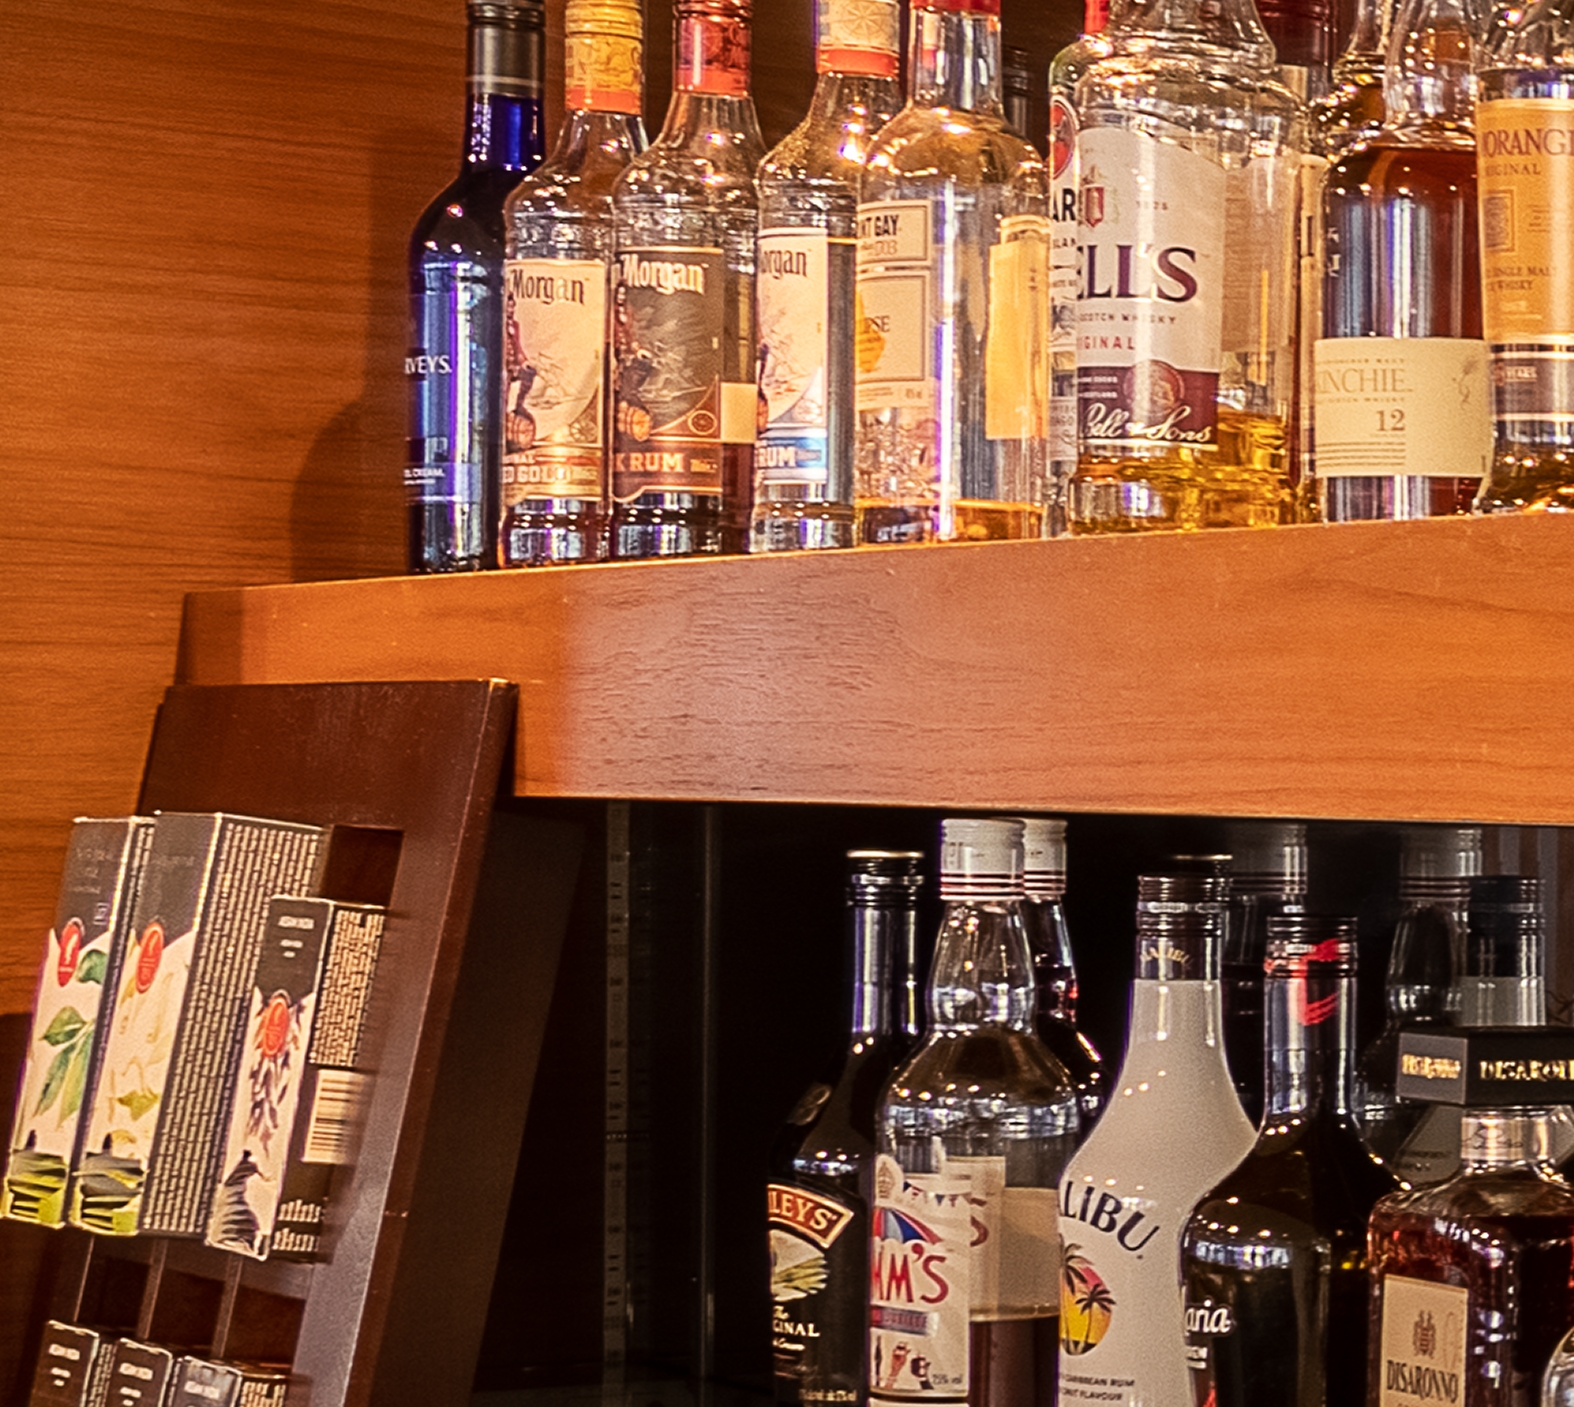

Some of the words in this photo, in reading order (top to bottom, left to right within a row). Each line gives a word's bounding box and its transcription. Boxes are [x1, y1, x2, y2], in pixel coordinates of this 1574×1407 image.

[508, 268, 586, 306] Morgan
[620, 253, 706, 294] Morgan
[1145, 405, 1212, 443] Sons
[1375, 408, 1406, 433] 12
[629, 452, 685, 473] RUM
[1386, 1359, 1459, 1405] DISARONNO
